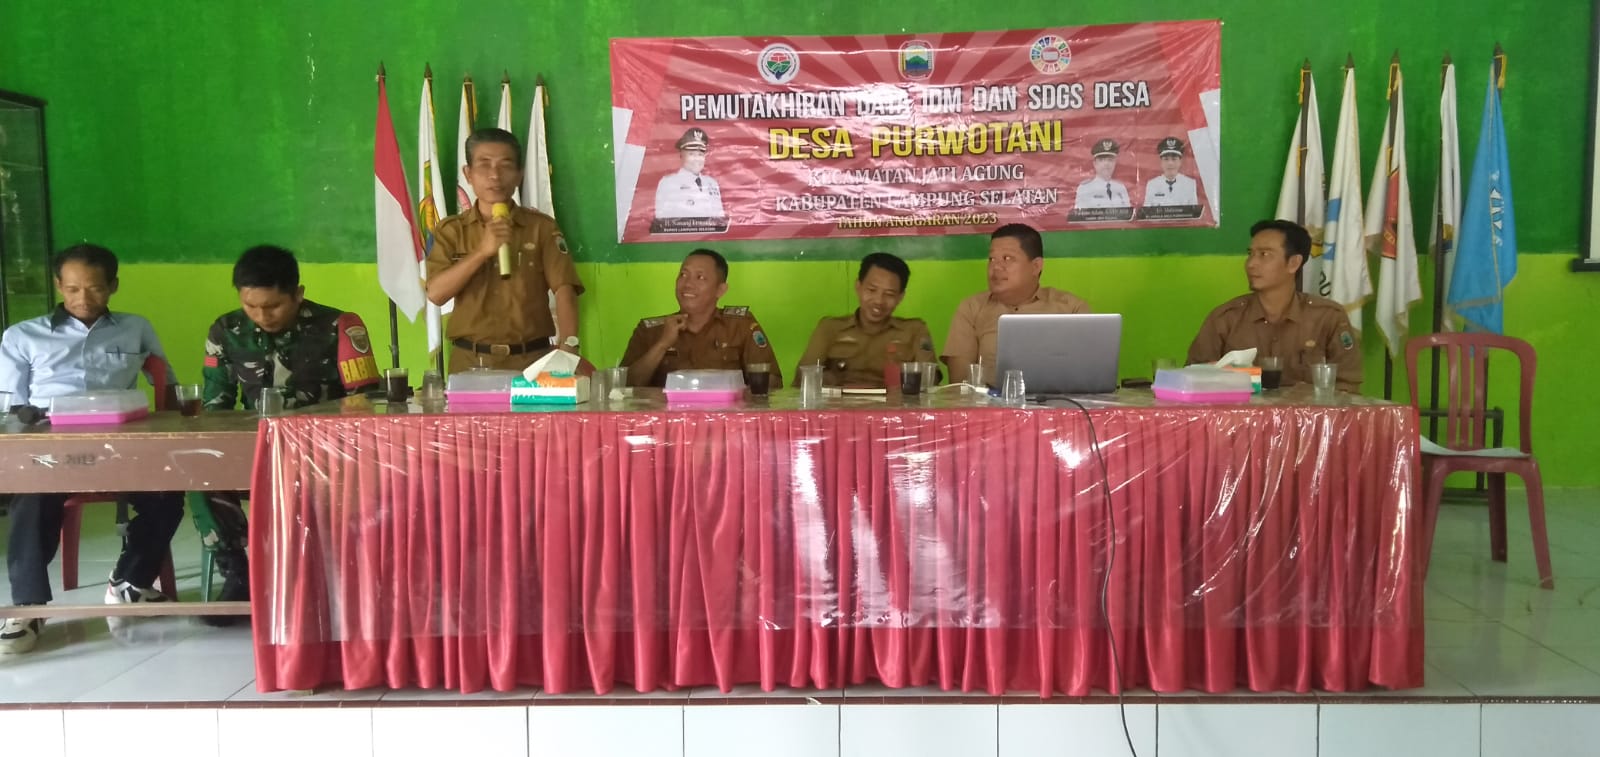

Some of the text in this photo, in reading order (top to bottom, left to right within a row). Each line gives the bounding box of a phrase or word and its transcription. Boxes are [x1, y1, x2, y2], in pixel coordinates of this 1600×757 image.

[680, 79, 1150, 121] PEMUTAKHIRAN DATA IDM DAN SDGS DESA
[768, 119, 1063, 160] DESA PURWOTANI
[808, 164, 1024, 186] KECAMATAN JATI AGUNG
[776, 187, 1058, 212] KABUPATEN LAMPUNG SELATAN
[838, 211, 997, 229] TAHUN ANGGARAN 2023
